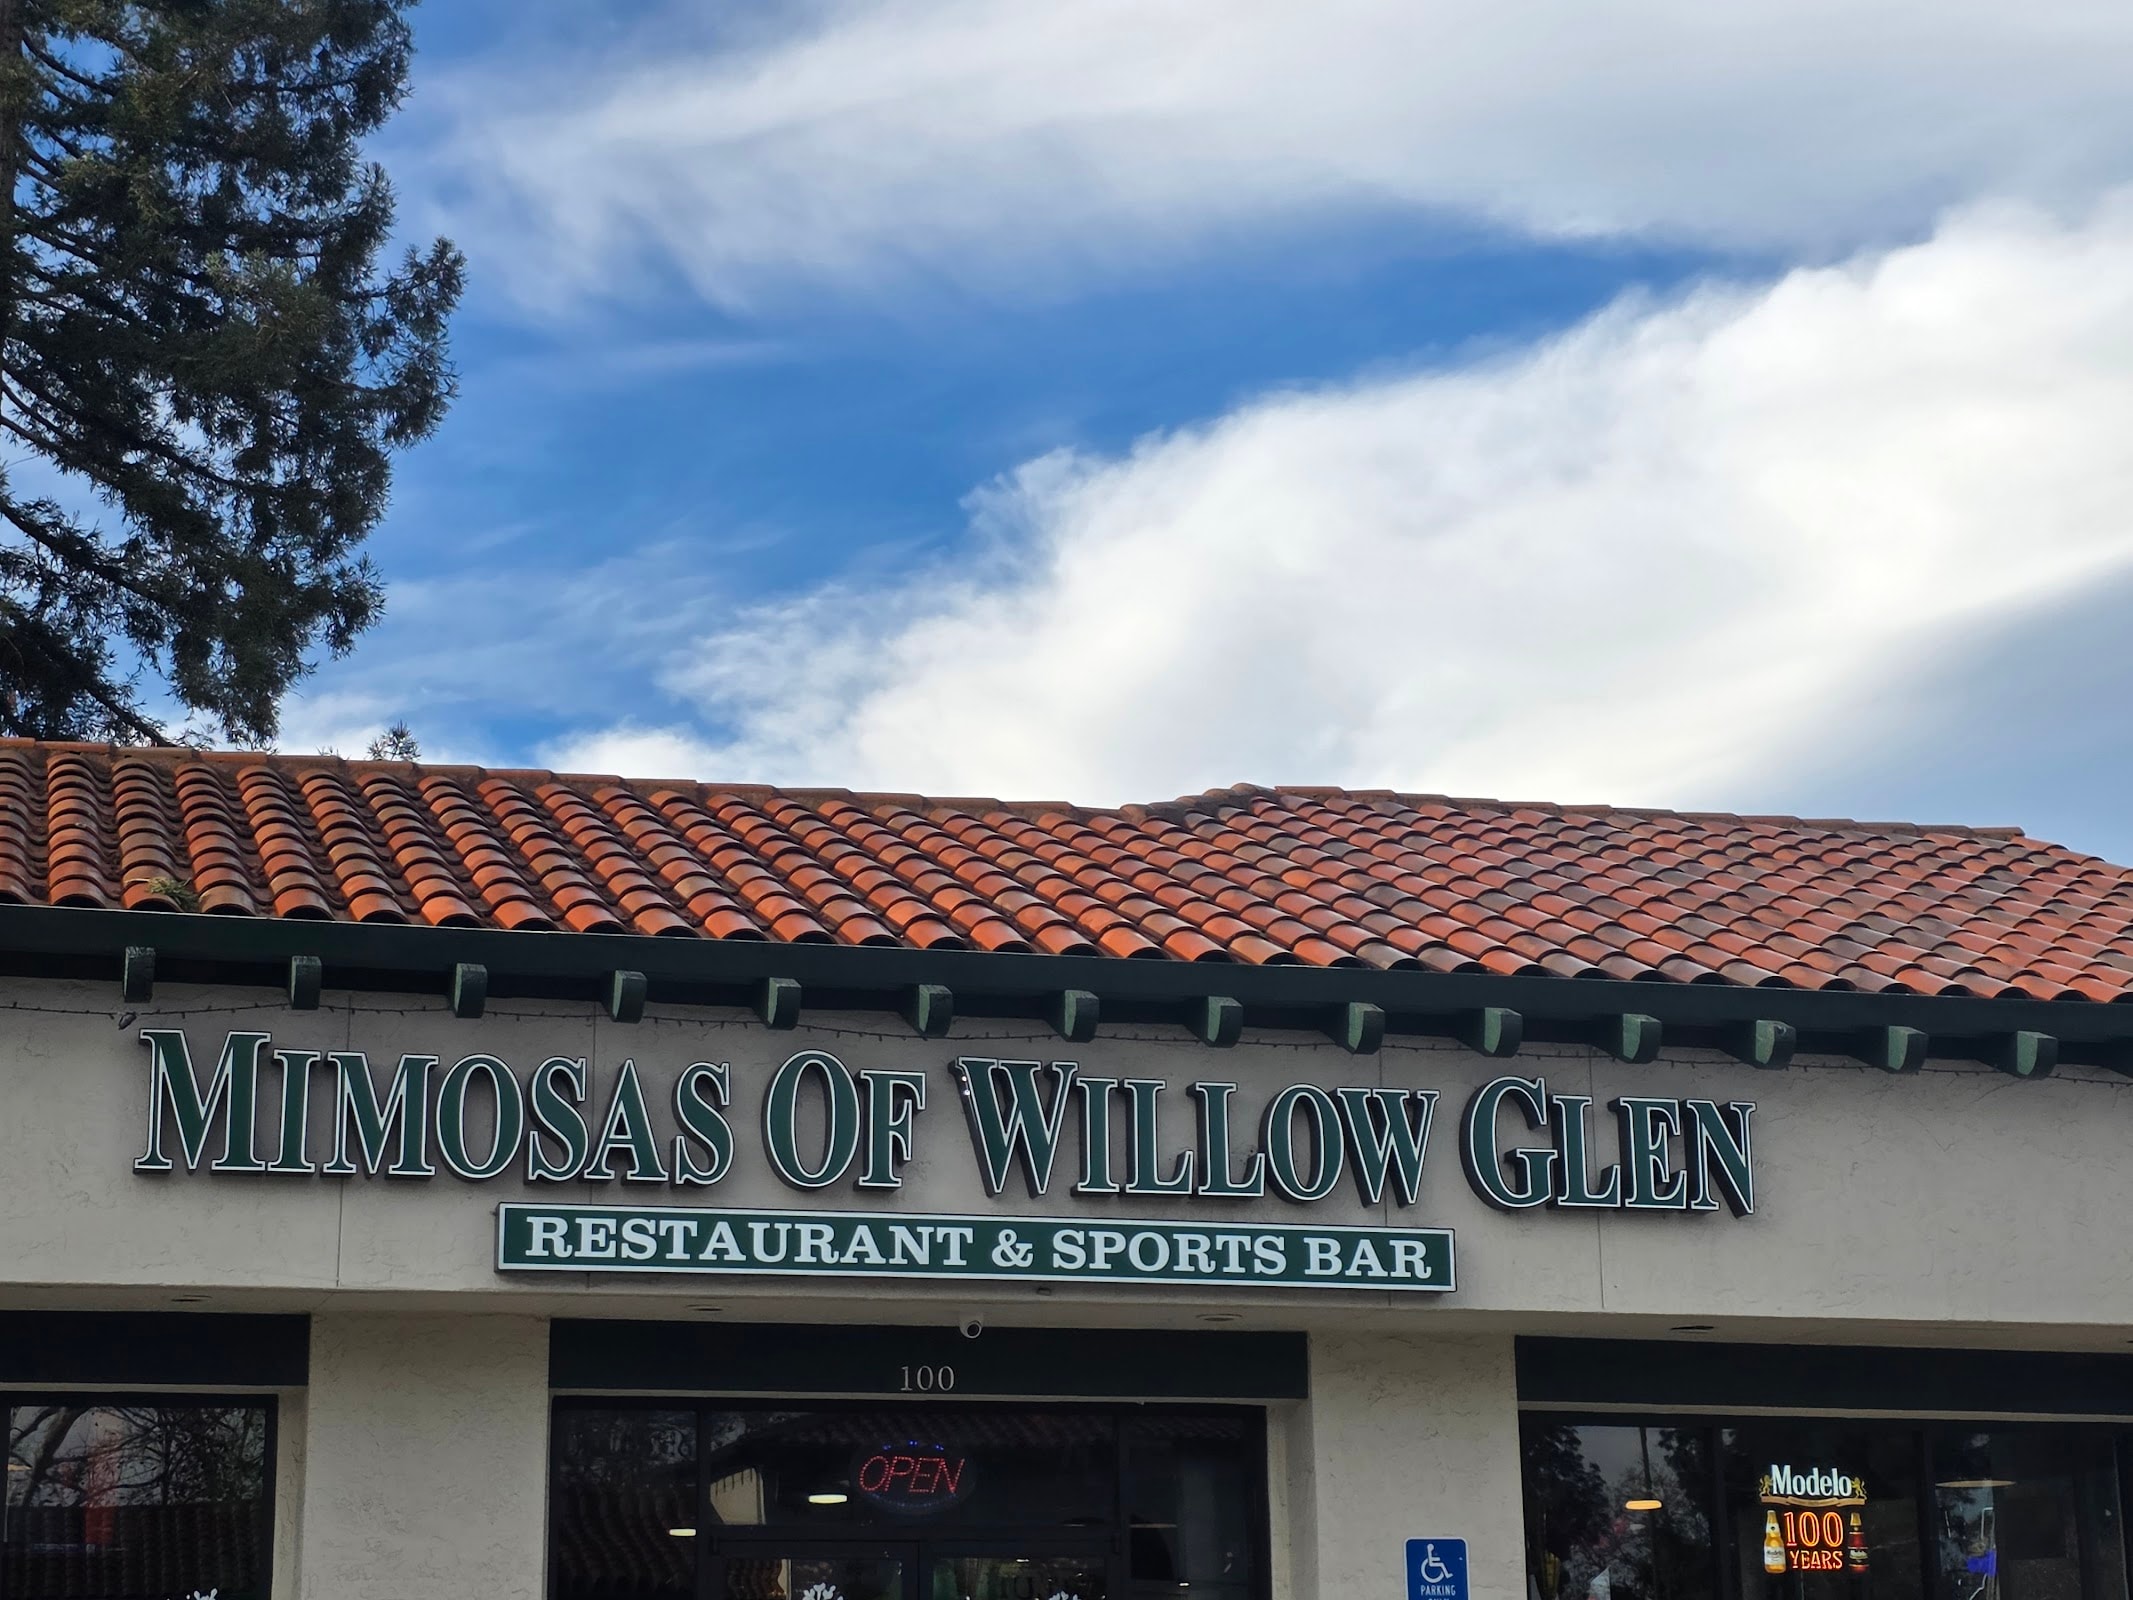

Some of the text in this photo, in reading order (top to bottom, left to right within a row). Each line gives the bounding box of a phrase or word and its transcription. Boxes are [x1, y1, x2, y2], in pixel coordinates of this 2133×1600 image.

[133, 1028, 1757, 1216] MIMOSAS OF WILLOW GLEN
[525, 1216, 1432, 1280] RESTAURANT & SPORTS BAR
[899, 1365, 956, 1392] 100
[859, 1455, 965, 1493] OPEN
[1770, 1463, 1852, 1497] Modelo
[1784, 1511, 1844, 1547] 100
[1790, 1550, 1843, 1569] YEARS
[1420, 1584, 1456, 1597] PARKING
